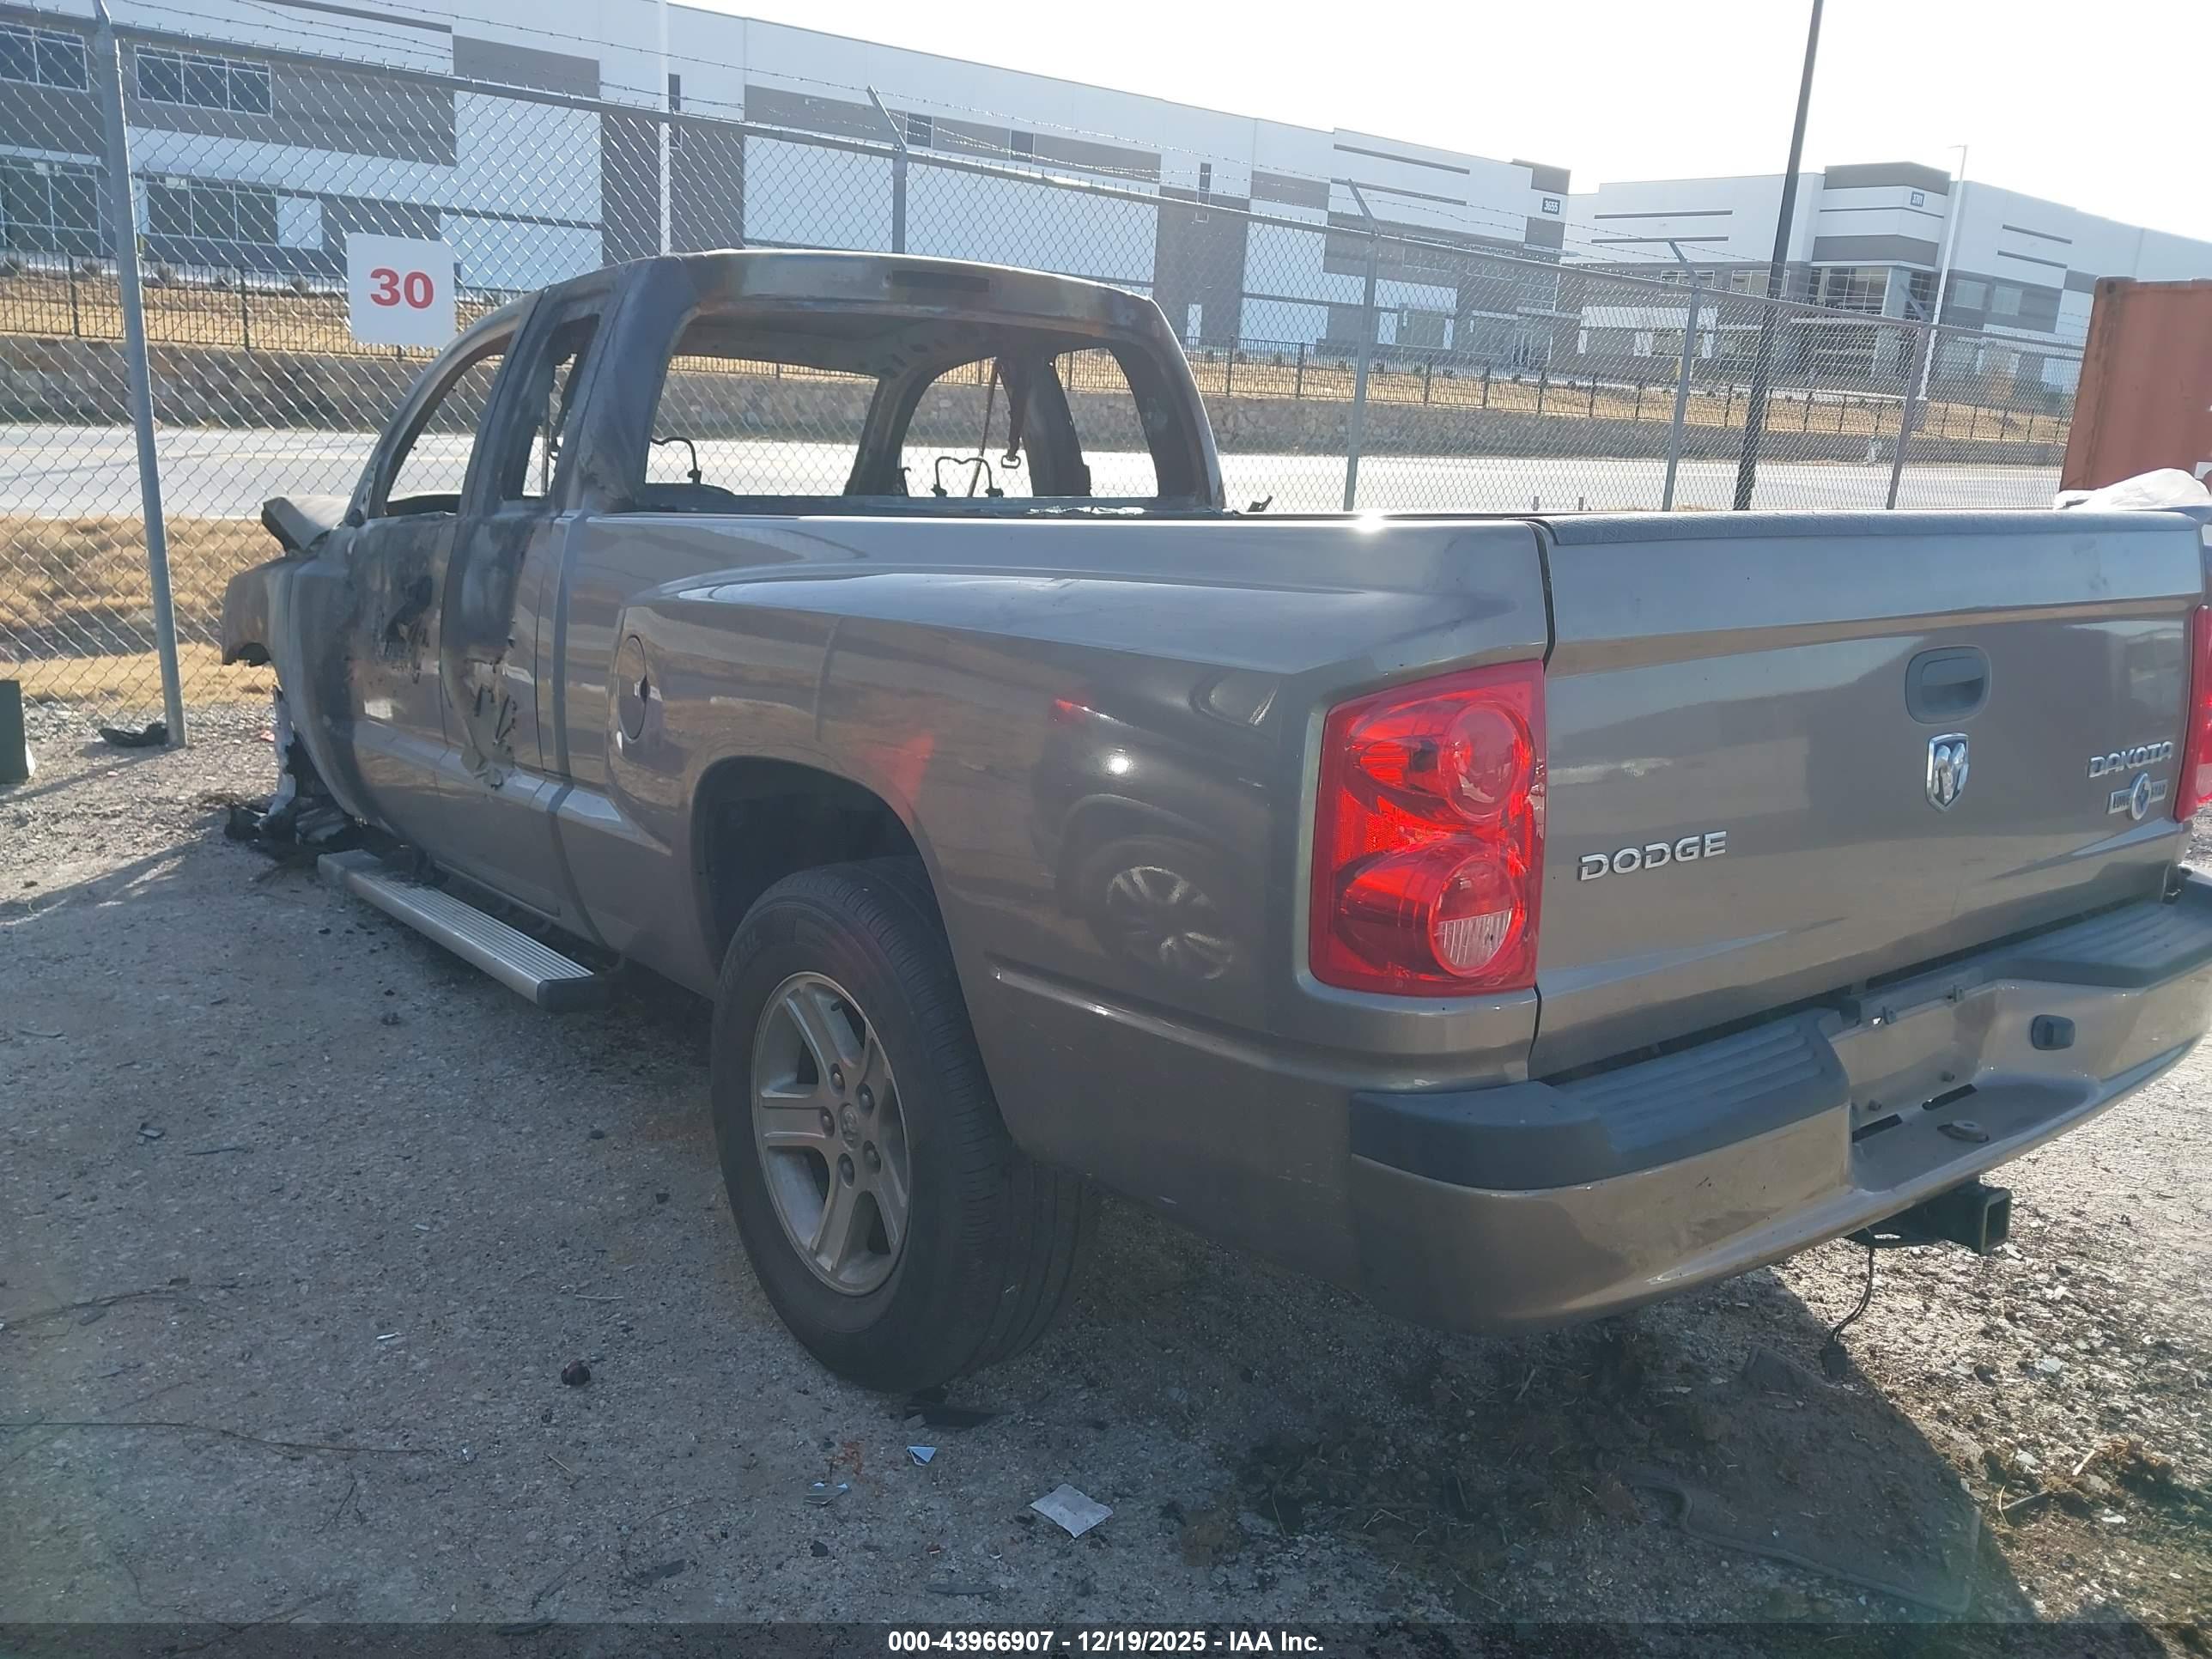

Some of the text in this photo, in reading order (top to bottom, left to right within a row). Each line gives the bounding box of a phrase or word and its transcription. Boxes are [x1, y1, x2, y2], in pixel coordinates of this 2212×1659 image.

[1544, 200, 1559, 213] 3655
[370, 268, 434, 309] 30
[2088, 741, 2172, 778] DAKOTA
[1578, 830, 1727, 881] DODGE
